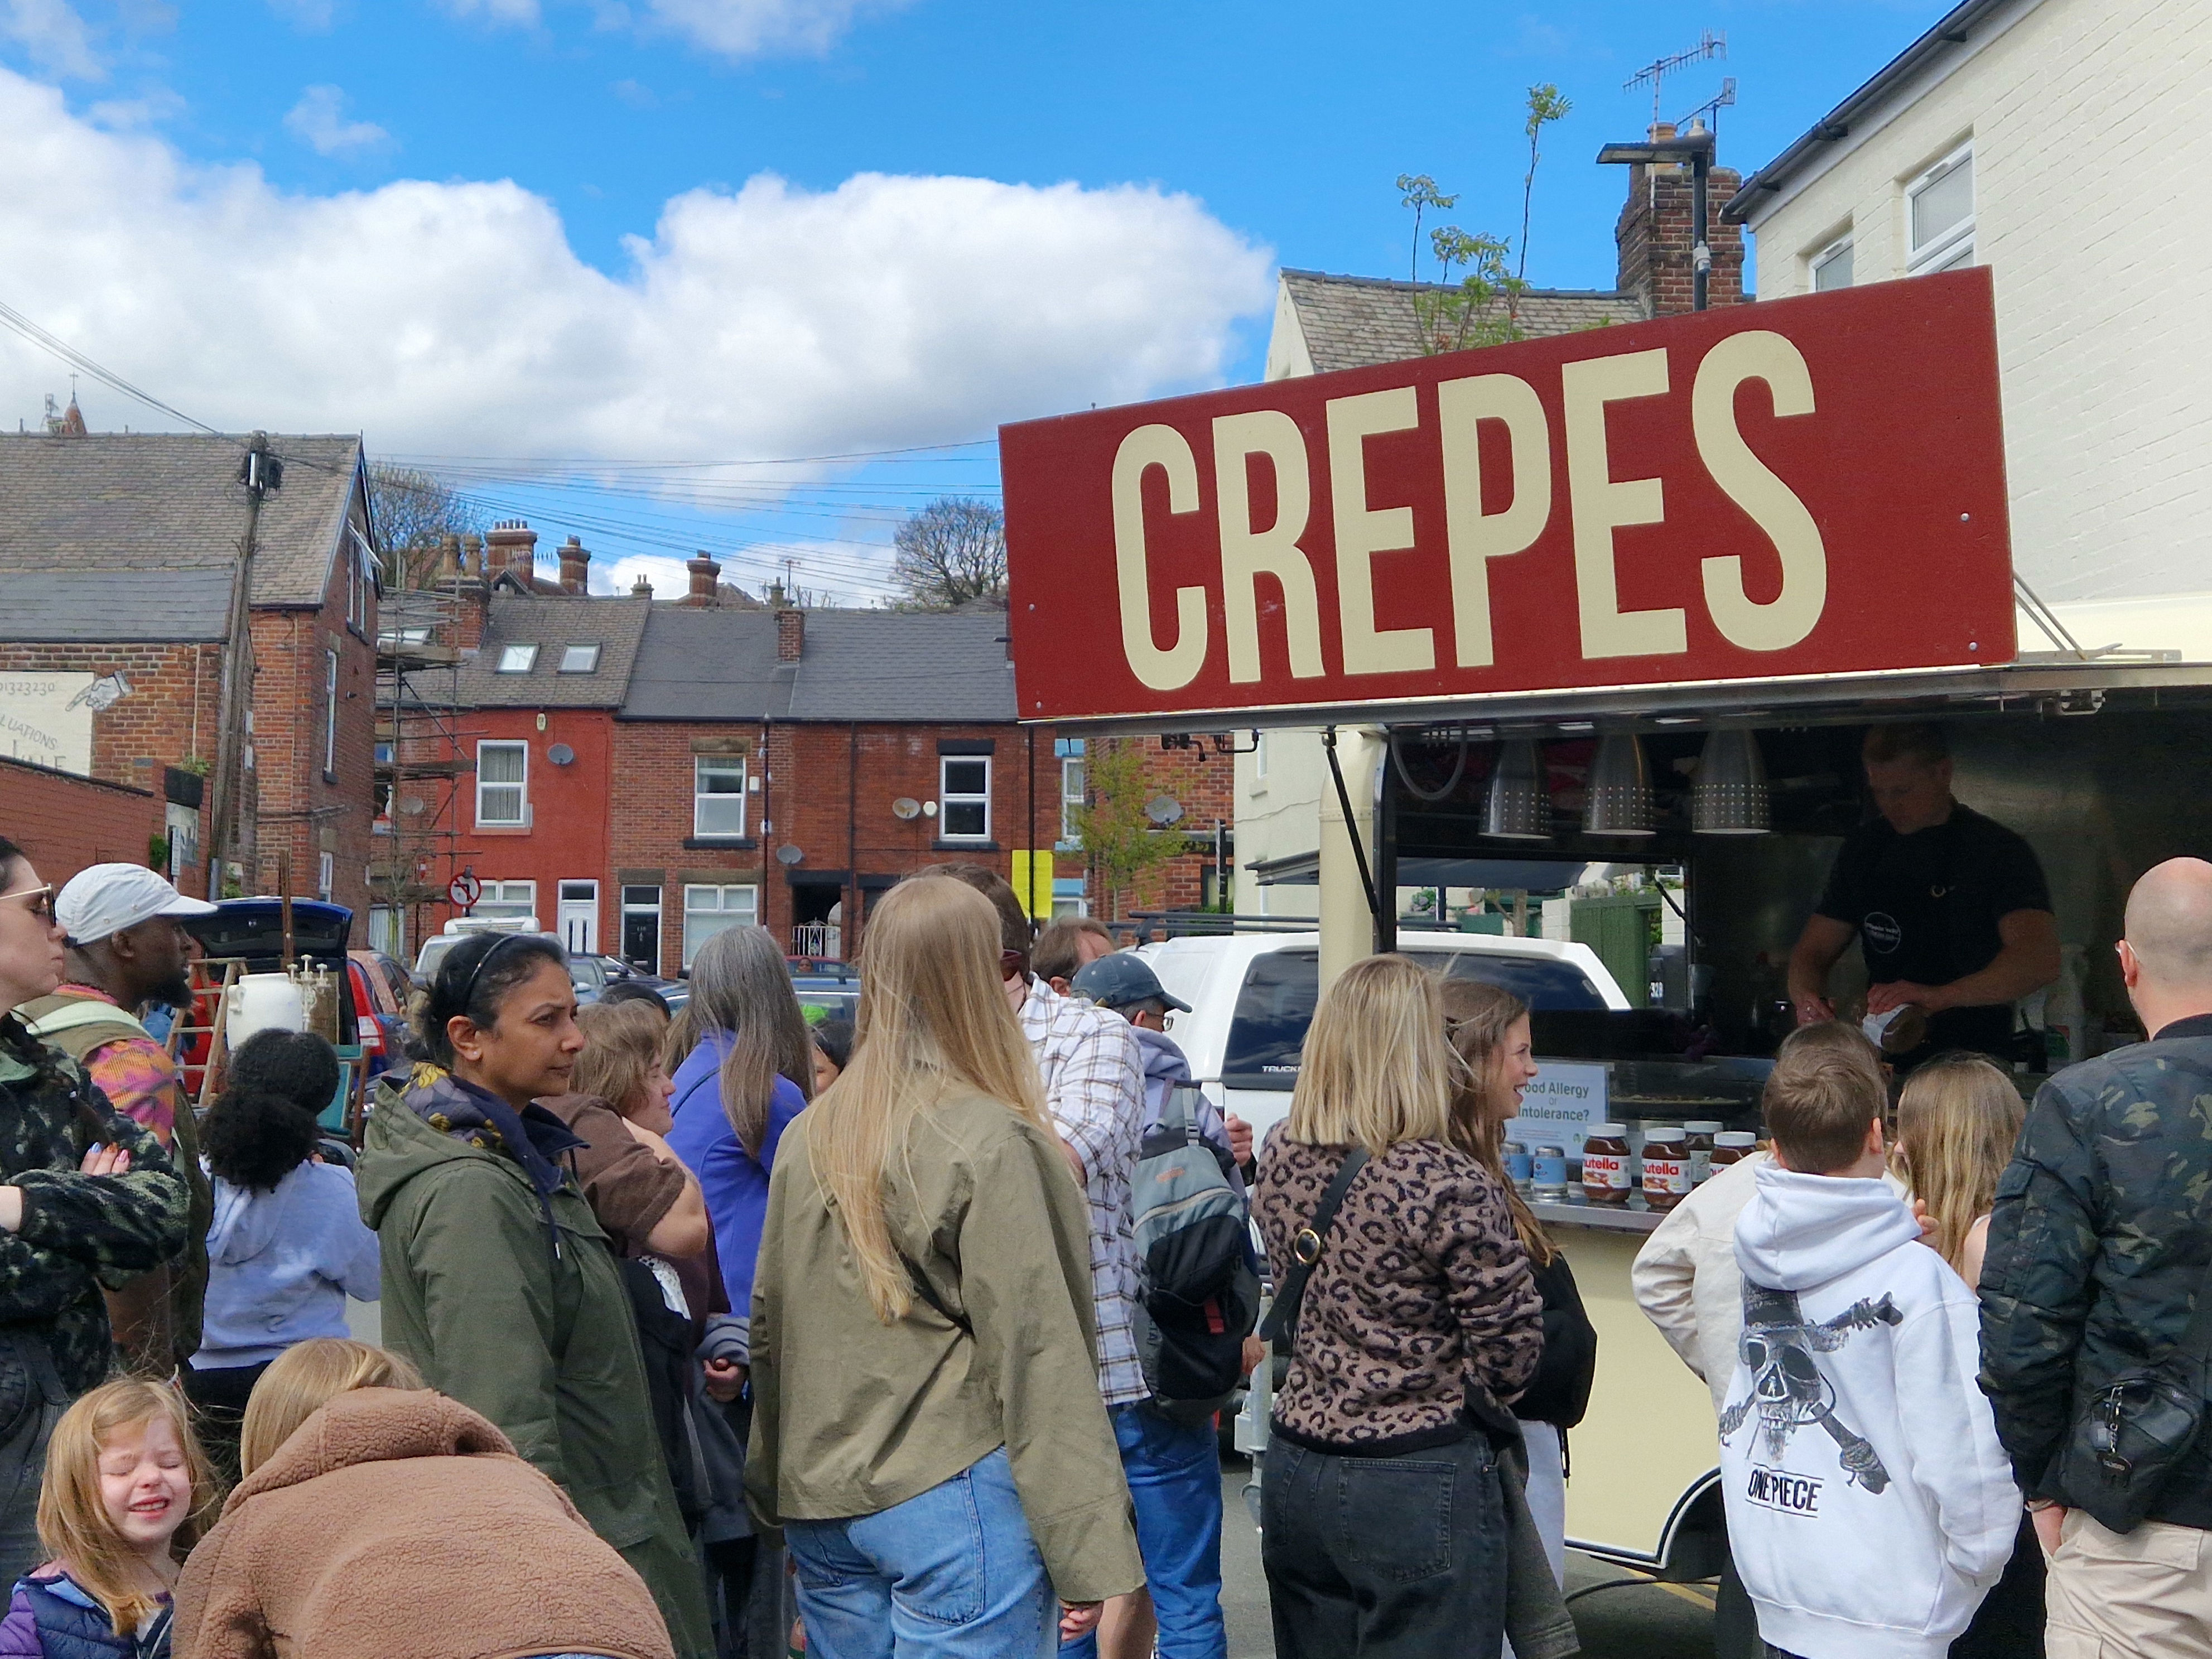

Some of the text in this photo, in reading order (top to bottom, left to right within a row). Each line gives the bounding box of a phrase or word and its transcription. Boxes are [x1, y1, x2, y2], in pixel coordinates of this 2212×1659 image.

[1111, 330, 1828, 691] CREPES
[1524, 1082, 1589, 1098] ood Allergy
[1519, 1105, 1590, 1122] Intolerance?
[1584, 1157, 1619, 1170] utella
